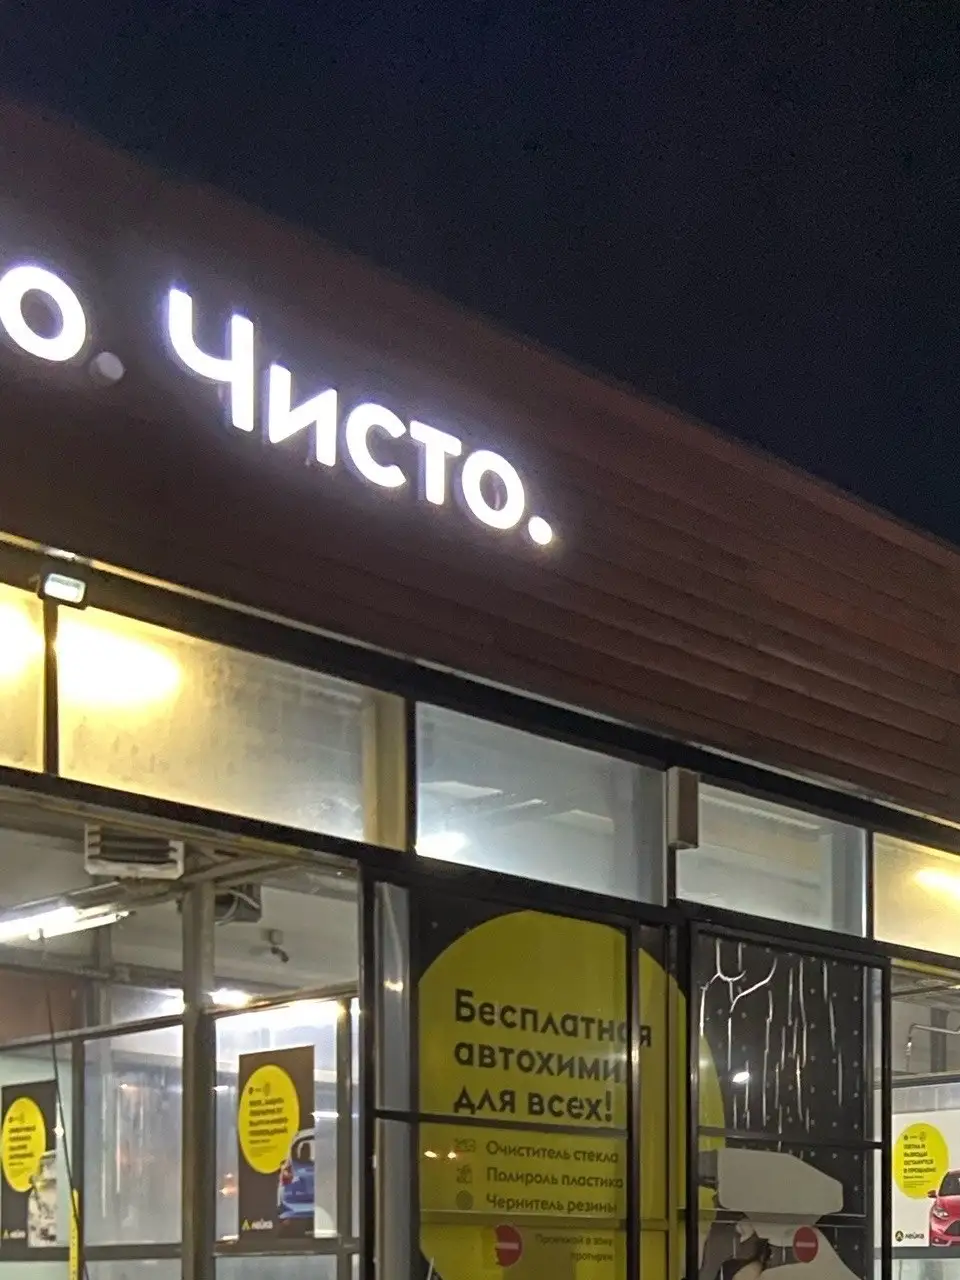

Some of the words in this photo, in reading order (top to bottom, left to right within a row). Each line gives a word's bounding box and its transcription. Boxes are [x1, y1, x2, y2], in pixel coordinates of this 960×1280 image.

[168, 287, 554, 546] Чисто.
[454, 1042, 627, 1084] автохими
[453, 1086, 516, 1115] для
[527, 1090, 613, 1123] всех!
[485, 1140, 571, 1160] Очиститель
[573, 1150, 618, 1164] стекла
[487, 1166, 558, 1186] Полироль
[561, 1174, 624, 1189] пластика
[486, 1193, 565, 1211] Чернитель
[567, 1200, 618, 1214] резины
